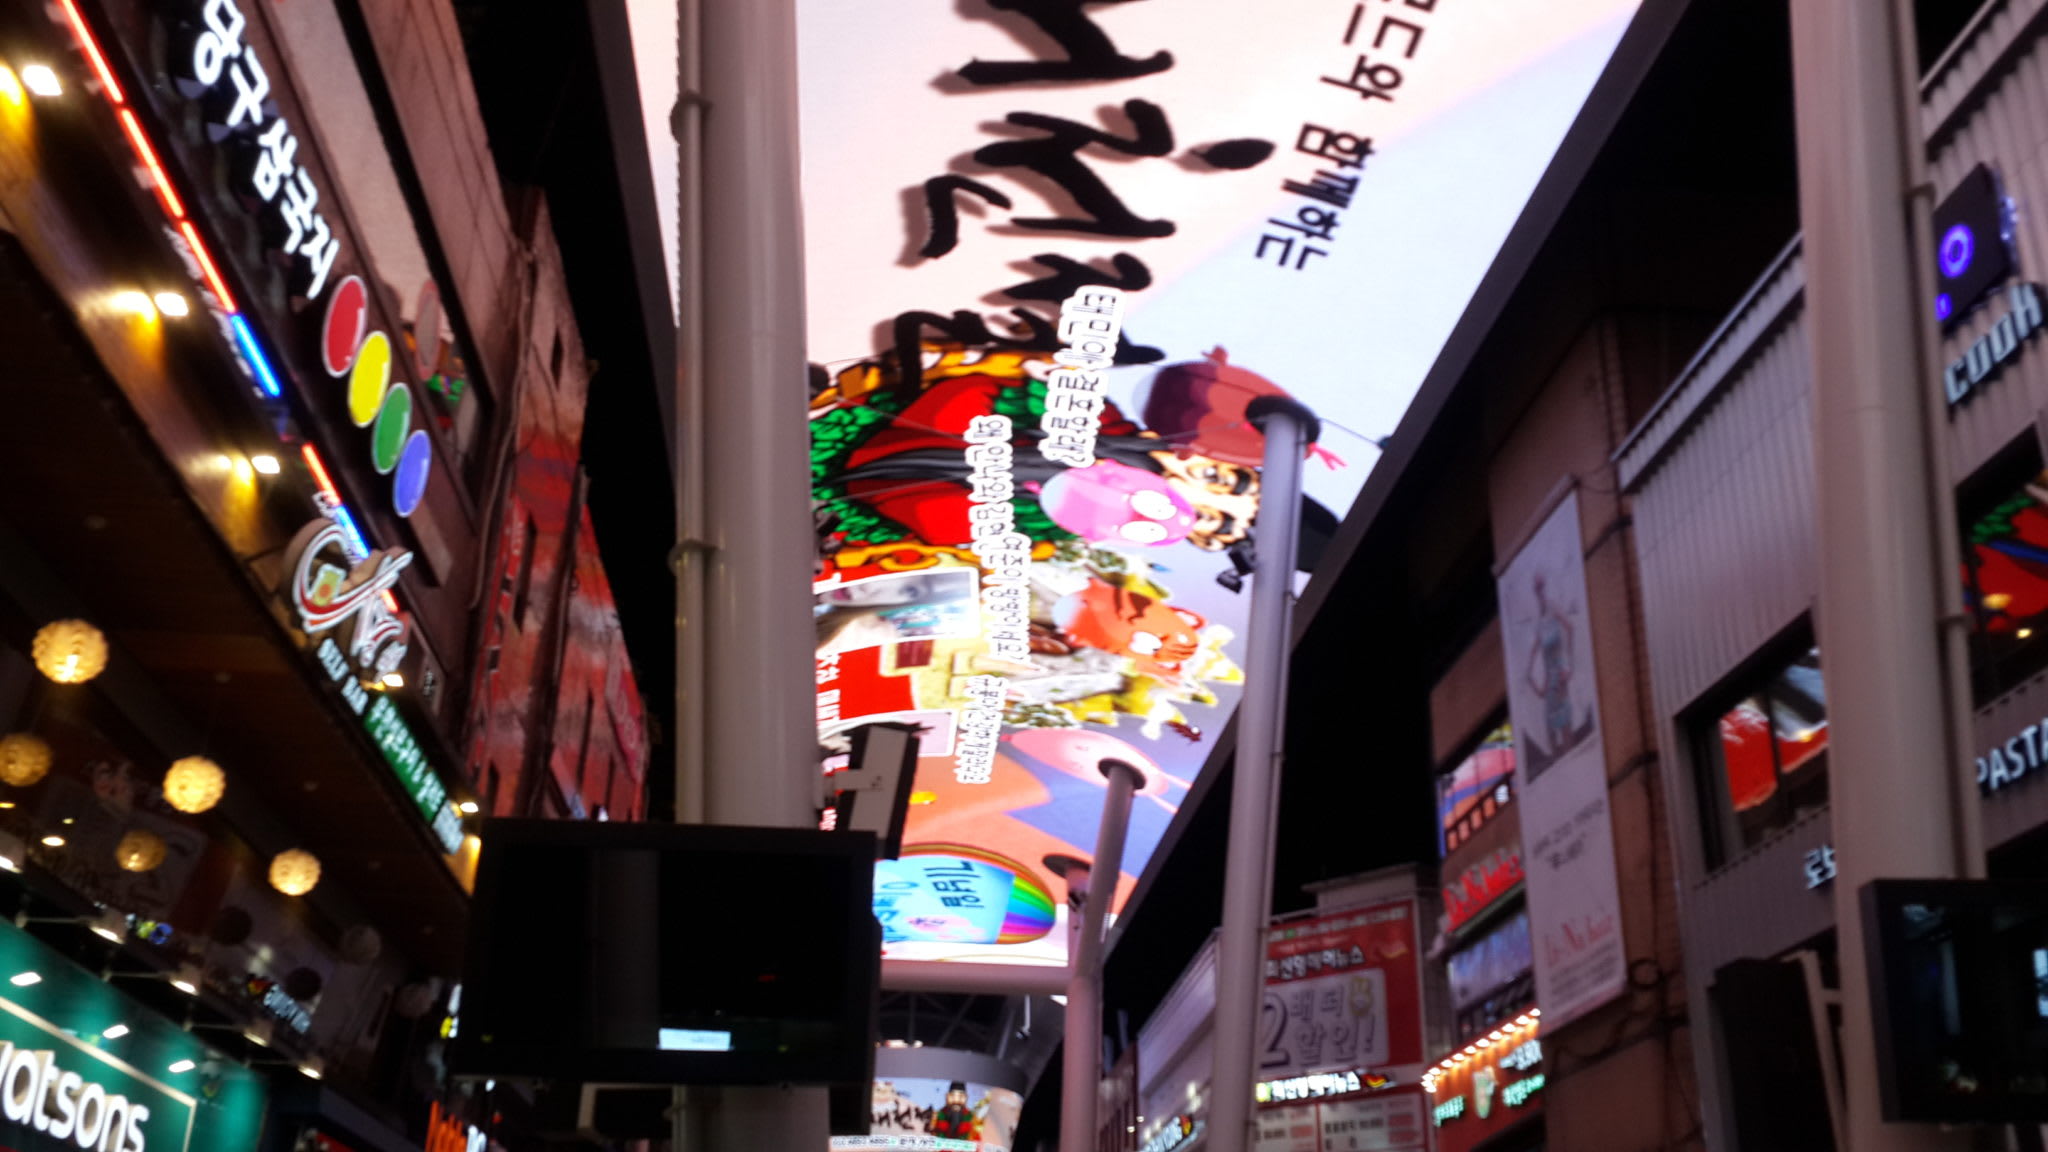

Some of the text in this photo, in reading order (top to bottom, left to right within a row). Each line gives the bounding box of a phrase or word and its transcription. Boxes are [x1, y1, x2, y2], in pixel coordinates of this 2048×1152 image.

[1255, 0, 1437, 272] 드와 함께하는
[924, 860, 985, 909] 기념일
